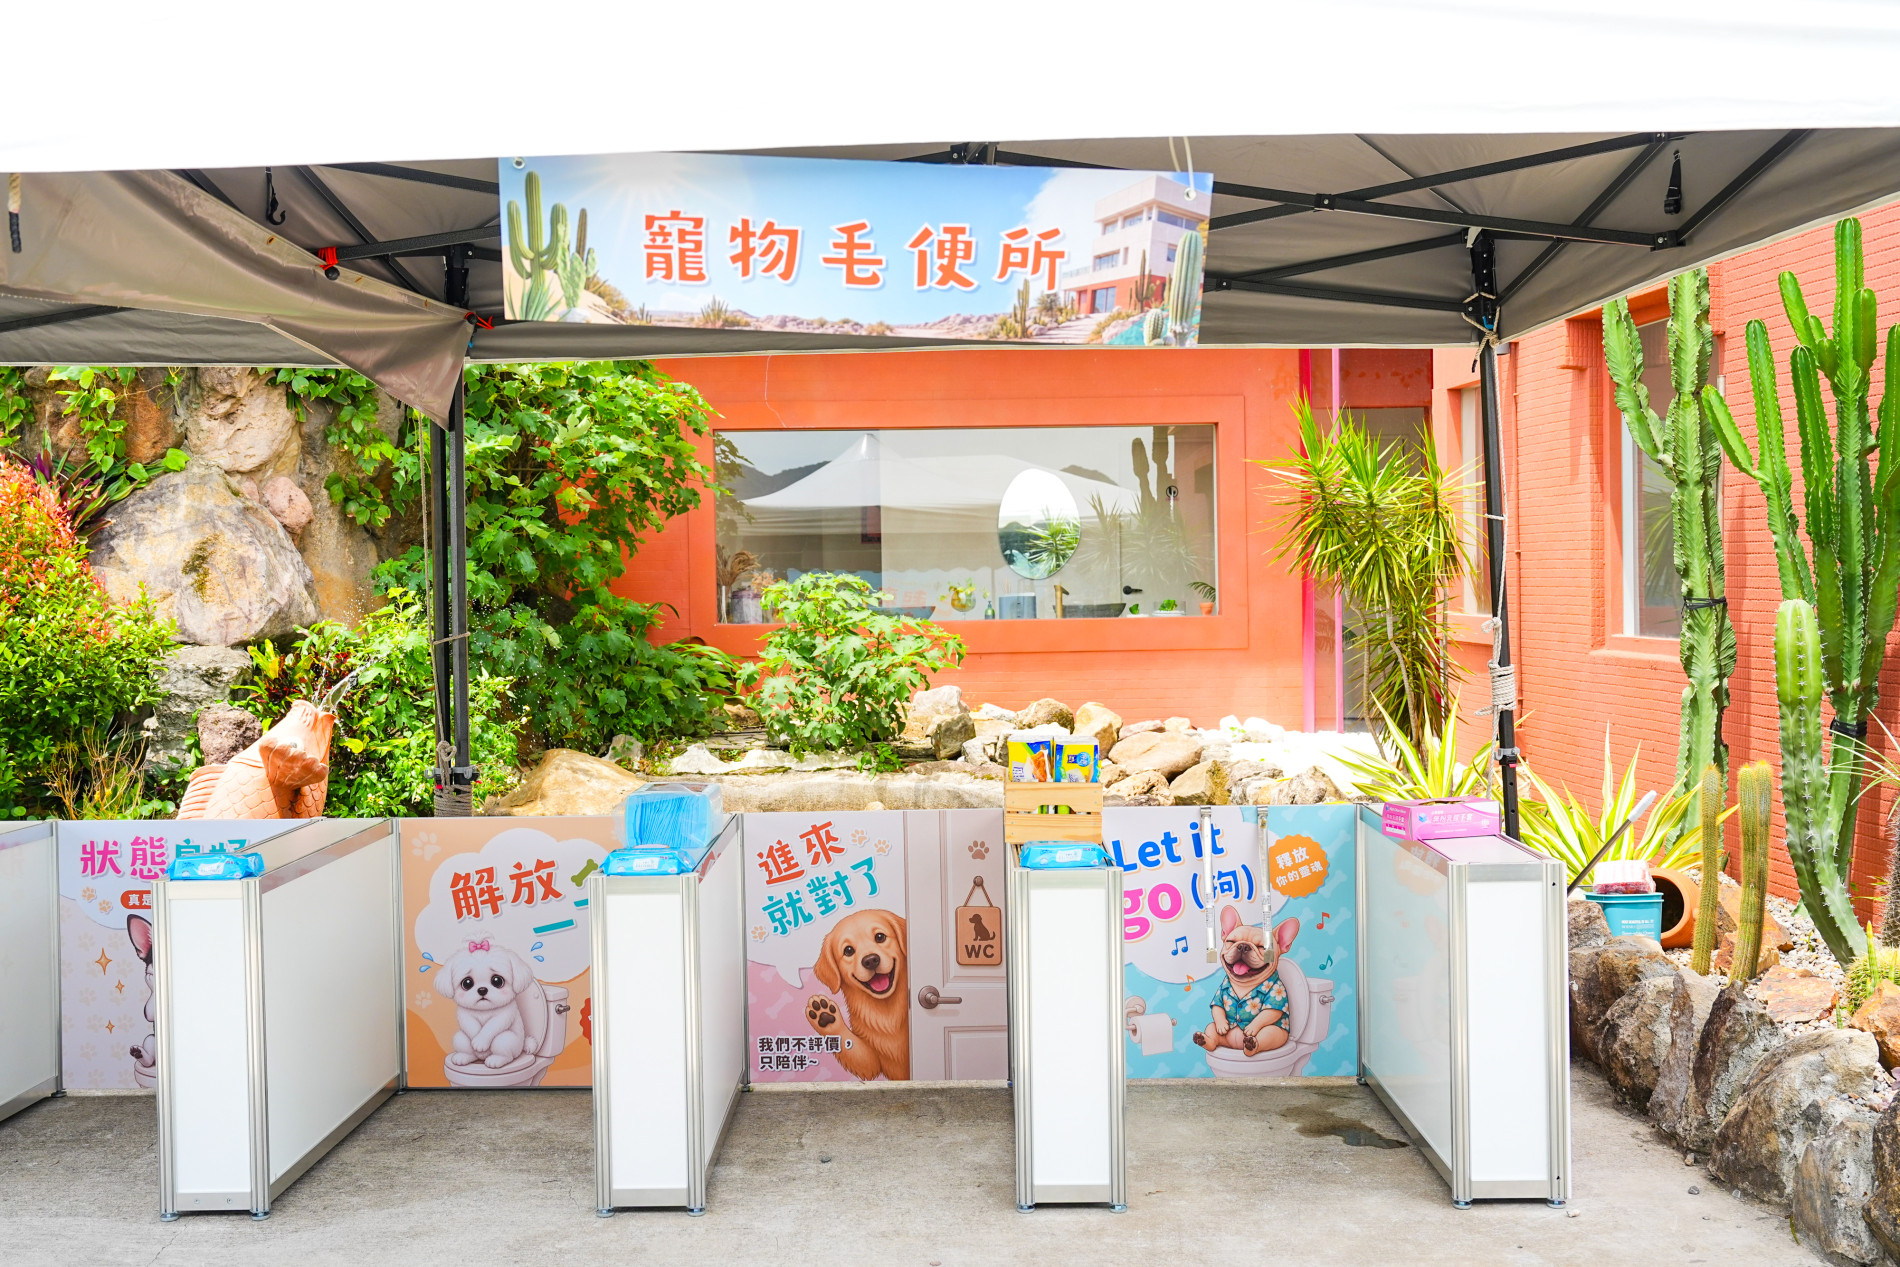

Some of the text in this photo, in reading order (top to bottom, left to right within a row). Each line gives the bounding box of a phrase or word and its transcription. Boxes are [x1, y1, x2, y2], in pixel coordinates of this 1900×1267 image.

[643, 210, 1068, 292] 寵物毛便所
[756, 820, 846, 885] 進來
[1112, 821, 1225, 873] Let it
[1275, 846, 1310, 870] 釋放
[1275, 860, 1324, 887] 你的靈魂
[449, 858, 563, 920] 解放
[761, 856, 879, 936] 就對了
[1123, 882, 1183, 941] go
[964, 944, 996, 959] WC
